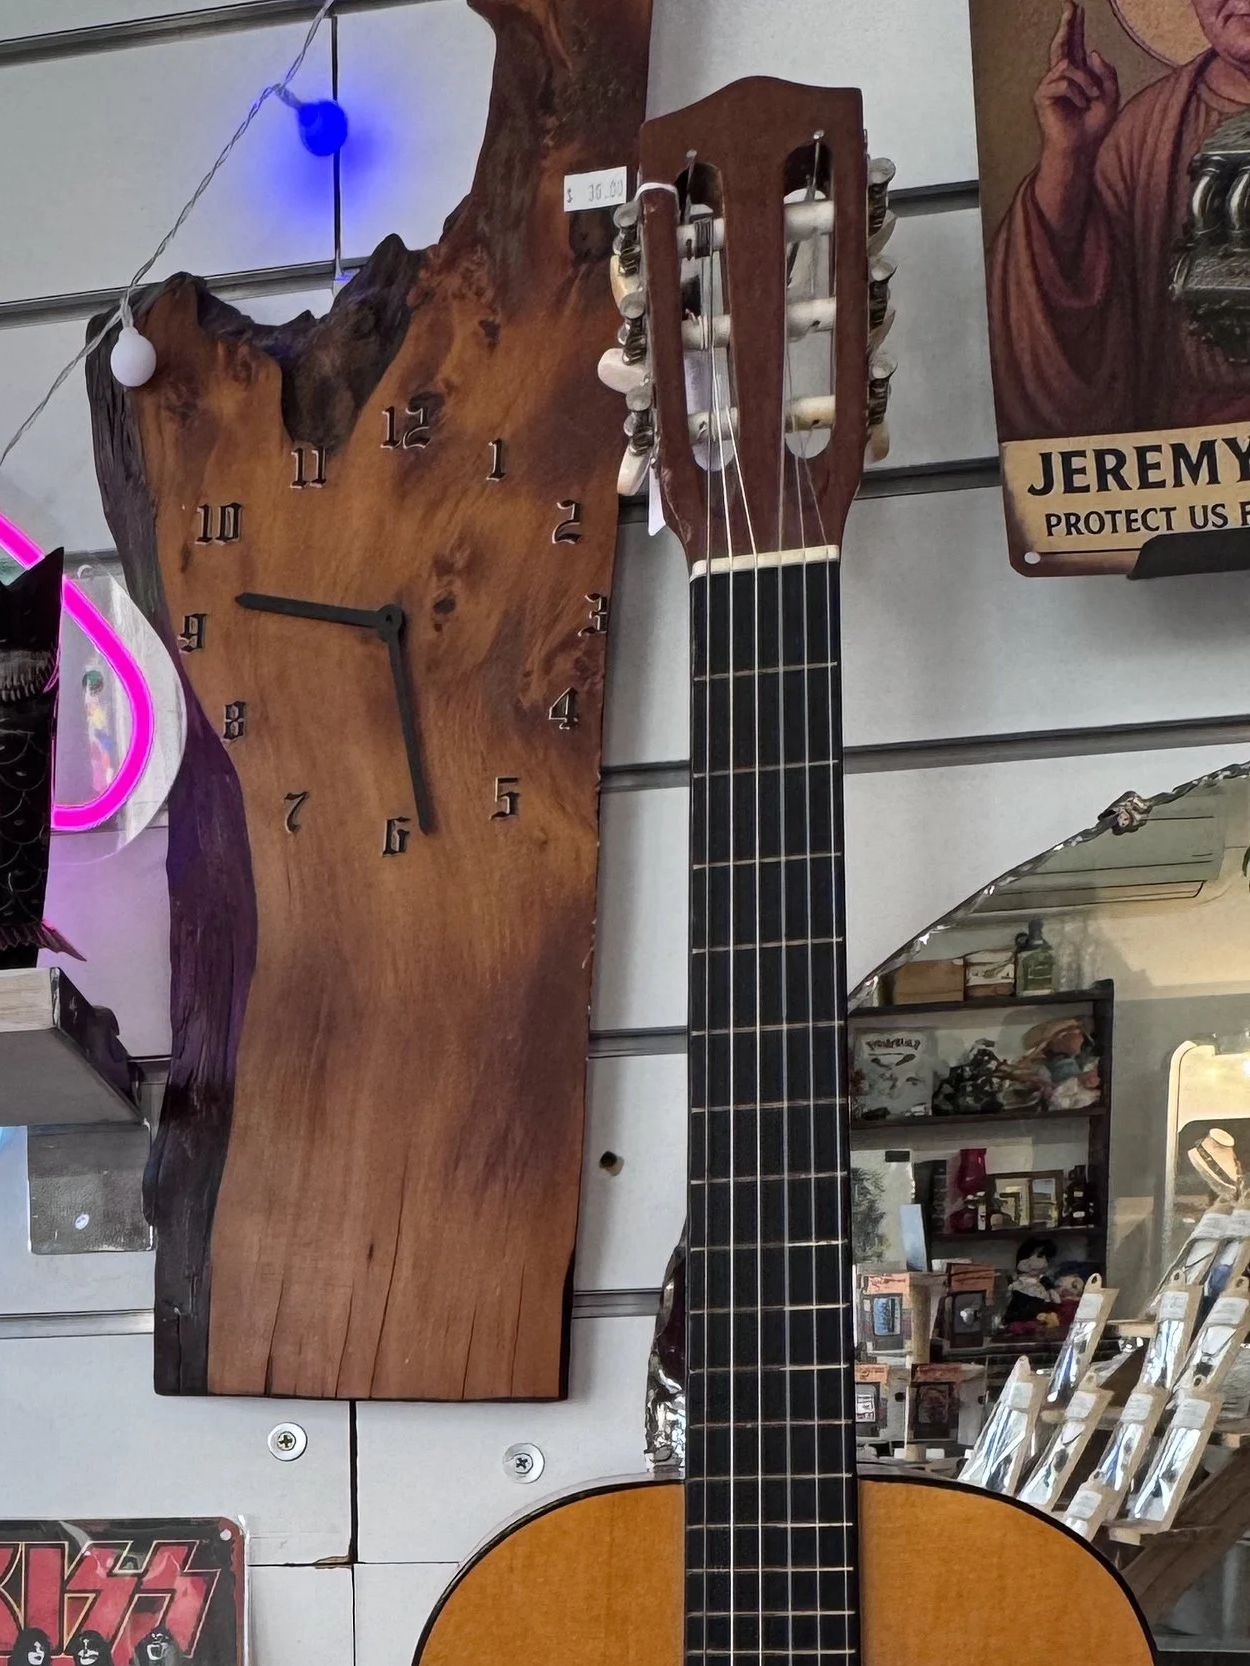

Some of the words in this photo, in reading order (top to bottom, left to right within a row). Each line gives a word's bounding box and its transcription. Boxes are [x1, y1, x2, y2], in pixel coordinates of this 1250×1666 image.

[381, 407, 432, 448] 12
[290, 446, 327, 489] 11
[486, 439, 505, 481] 1
[1027, 434, 1250, 496] JEREMY
[194, 502, 243, 545] 10
[551, 500, 582, 544] 2
[1045, 506, 1177, 537] PROTECT
[1189, 503, 1229, 530] US
[178, 613, 206, 653] 9
[578, 592, 608, 637] 3
[222, 700, 245, 742] 8
[549, 687, 580, 730] 4
[283, 791, 309, 833] 7
[490, 776, 519, 820] 5
[382, 817, 411, 857] 6
